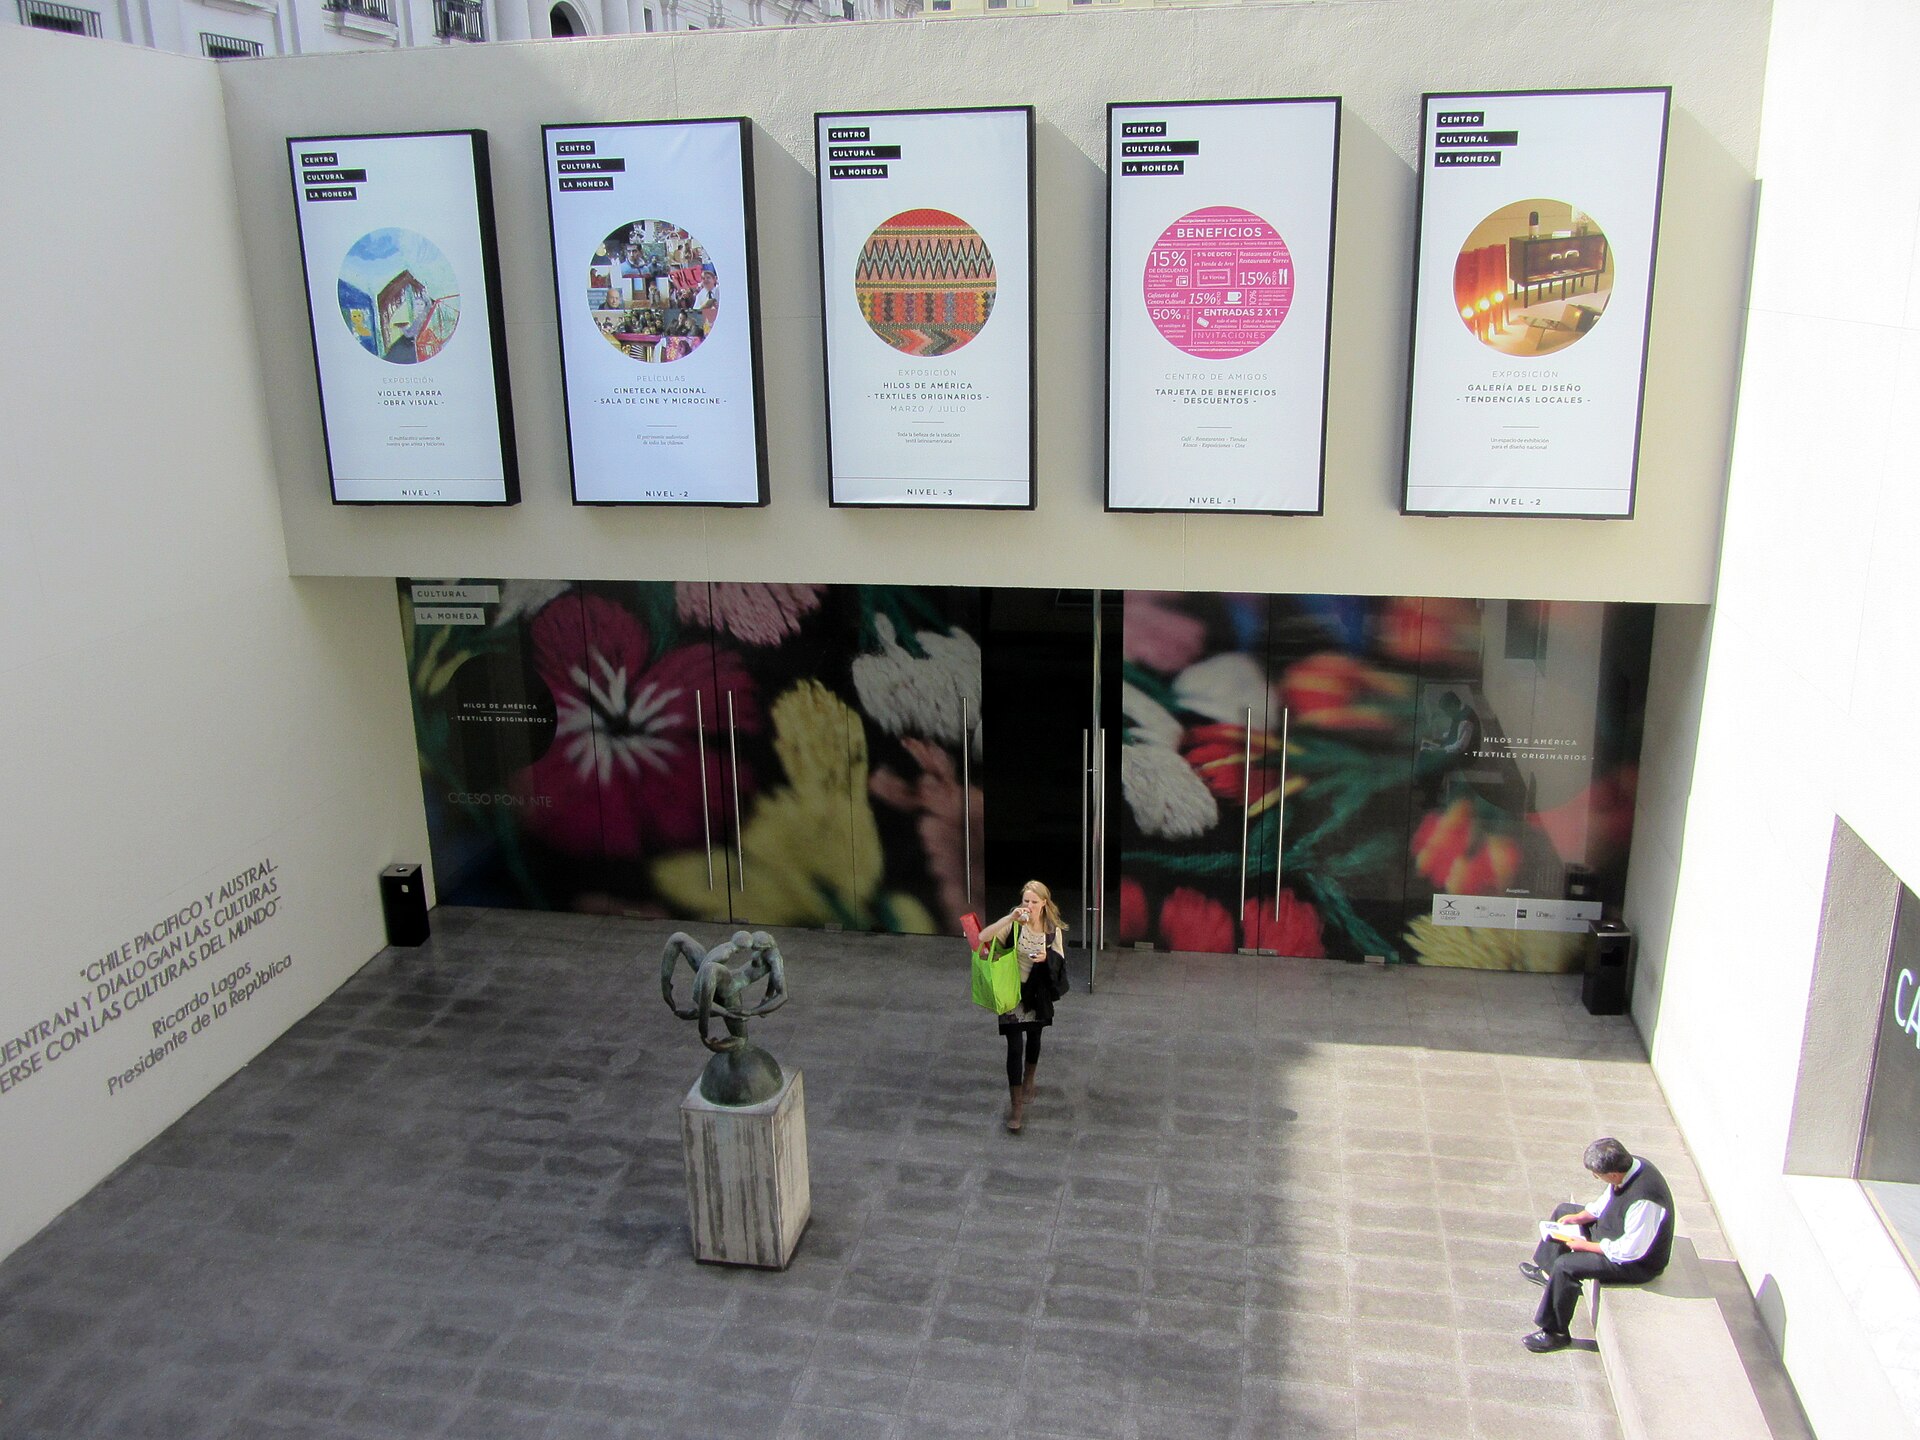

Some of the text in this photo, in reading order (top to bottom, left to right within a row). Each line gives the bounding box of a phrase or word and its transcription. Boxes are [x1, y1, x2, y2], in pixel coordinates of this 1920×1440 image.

[832, 149, 875, 157] CULTURAL
[1126, 145, 1171, 153] CULTURAL
[1177, 228, 1262, 238] BENEFICIOS
[1151, 251, 1187, 267] 15%
[1239, 271, 1272, 286] 15%
[1189, 292, 1216, 304] 15%
[1153, 309, 1182, 320] 50%
[1204, 308, 1255, 316] ENTRADAS
[1257, 308, 1263, 316] 2
[1265, 308, 1272, 316] X
[1194, 331, 1266, 339] INVITACIONES
[898, 368, 957, 376] EXPOSICIÓN
[1492, 369, 1559, 378] EXPOSICIÓN
[636, 374, 686, 382] PELÍCULAS
[1228, 373, 1268, 381] AMIGOS
[930, 381, 973, 390] AMÉRICA
[1467, 383, 1513, 392] GALERÍA
[1541, 383, 1582, 392] DISEÑO
[1155, 388, 1197, 396] TARJETA
[1535, 396, 1583, 404] LOCALES
[417, 590, 467, 598] CULTURAL
[1483, 736, 1512, 744] HILOS
[1472, 751, 1587, 761] TEXTILES ORIGINARIOS
[134, 901, 202, 954] PACIFICO
[205, 892, 213, 909] Y
[81, 992, 92, 1010] Y
[97, 936, 181, 1002] DIALOGAN
[184, 919, 211, 947] LAS
[214, 877, 277, 926] CULTURAS
[46, 1021, 89, 1061] CON
[91, 1001, 121, 1032] LAS
[124, 951, 197, 1010] CULTURAS
[200, 934, 226, 961] DEL
[152, 961, 251, 1038] Ricardo Lagos
[107, 955, 292, 1096] Presidente de la República
